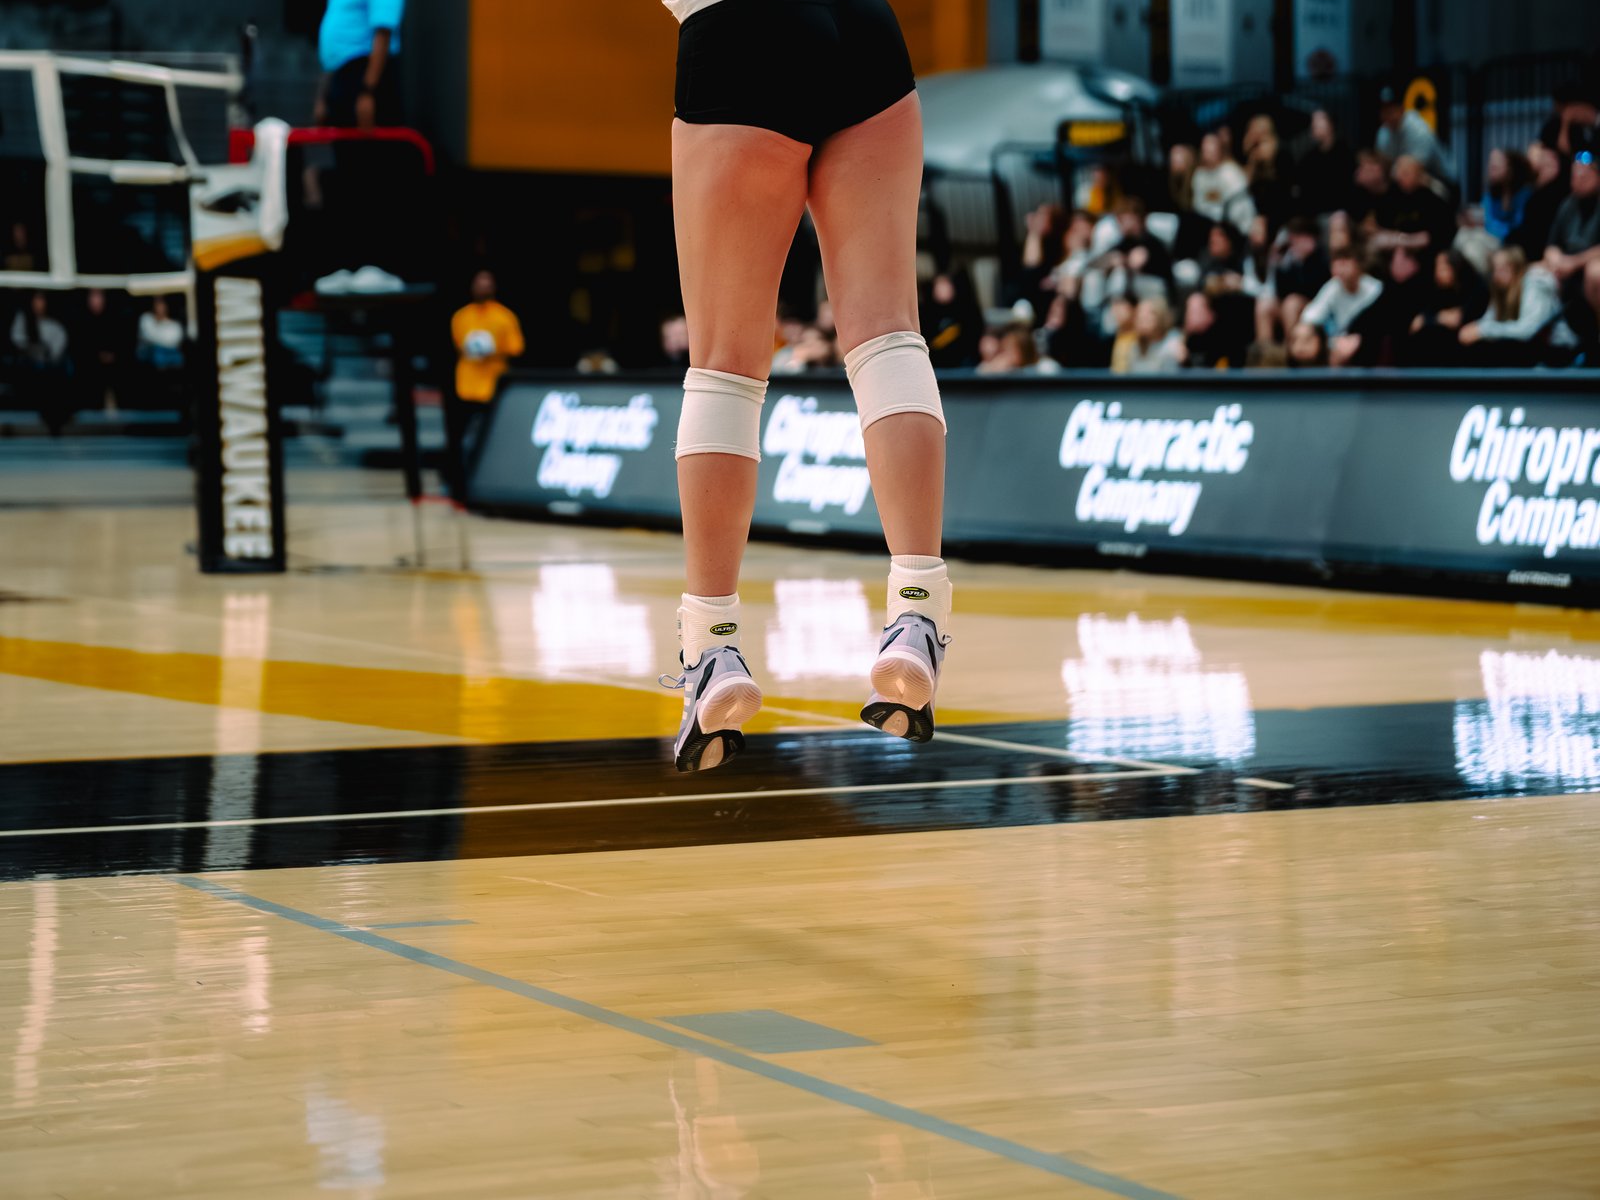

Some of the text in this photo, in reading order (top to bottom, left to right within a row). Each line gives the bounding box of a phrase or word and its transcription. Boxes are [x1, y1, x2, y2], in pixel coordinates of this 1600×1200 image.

[214, 276, 273, 559] MILWAUKEE
[1058, 399, 1254, 480] Chiropractic
[1075, 463, 1202, 536] Company
[902, 589, 925, 598] ULTRA
